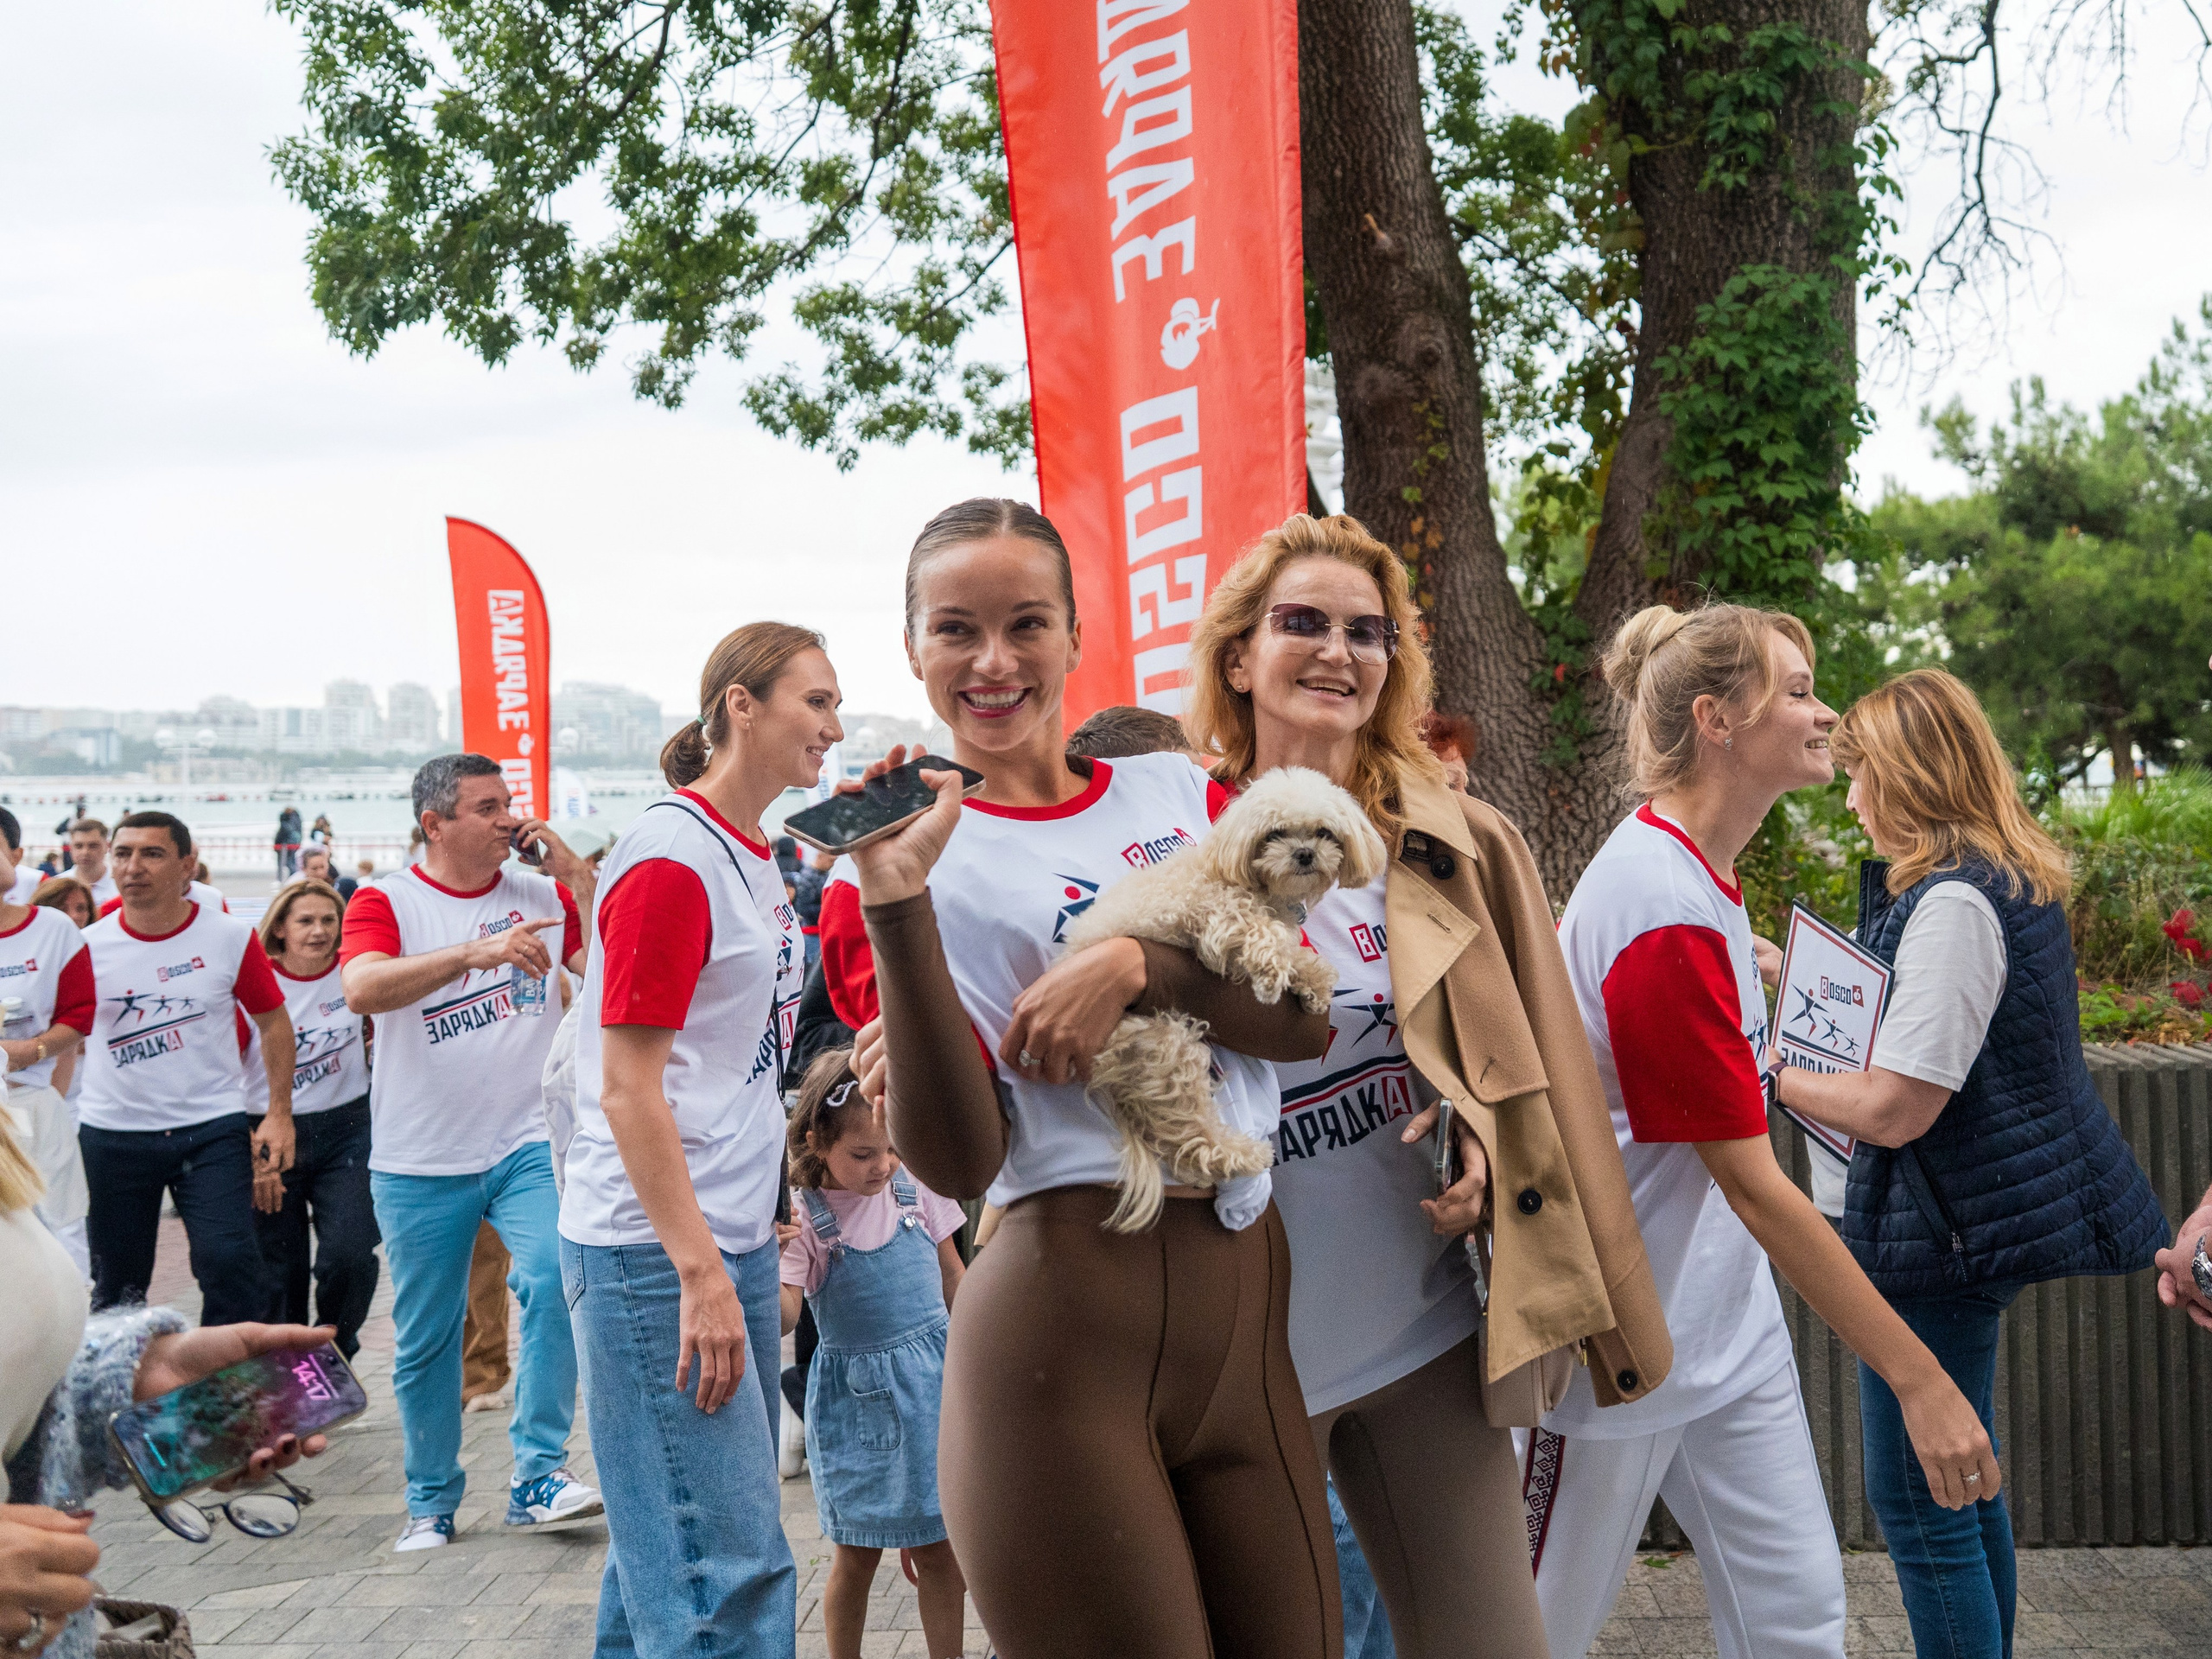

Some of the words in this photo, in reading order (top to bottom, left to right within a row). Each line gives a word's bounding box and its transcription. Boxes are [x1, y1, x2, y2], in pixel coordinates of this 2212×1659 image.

[1820, 976, 1852, 1006] BOSCO
[425, 994, 511, 1044] ЗАРЯДКА
[1274, 1076, 1413, 1166] АРЯДКА
[292, 1360, 332, 1401] 14:17
